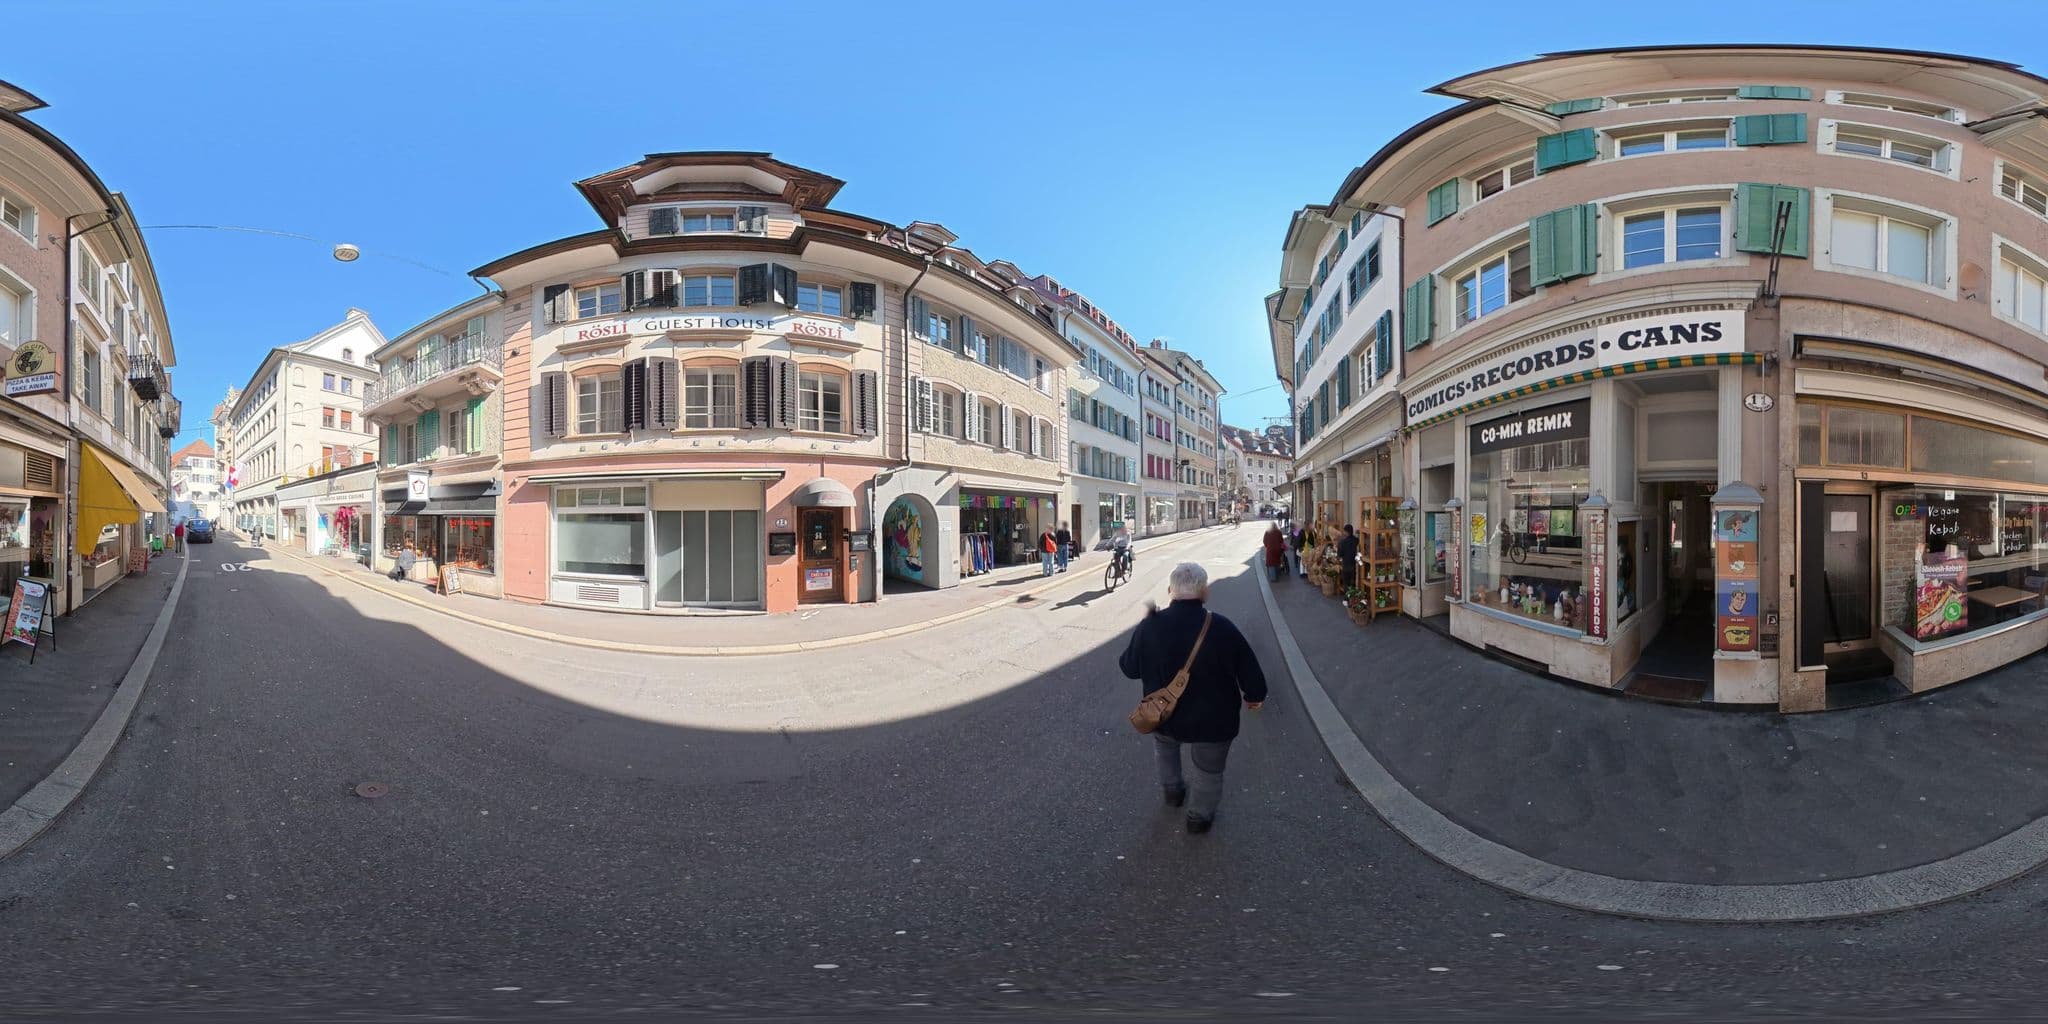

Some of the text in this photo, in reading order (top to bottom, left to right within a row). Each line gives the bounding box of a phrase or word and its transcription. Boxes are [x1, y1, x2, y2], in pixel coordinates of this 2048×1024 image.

[578, 316, 843, 341] RÖSLI GUEST HOUSE RÖSLI
[1408, 321, 1723, 418] COMICS RECORDS CANS
[28, 382, 48, 390] AWAY
[1481, 412, 1572, 444] CO-MIX REMIX
[1928, 505, 1960, 520] Vegane
[1929, 521, 1960, 536] Kebab
[1593, 566, 1601, 635] RECORDS
